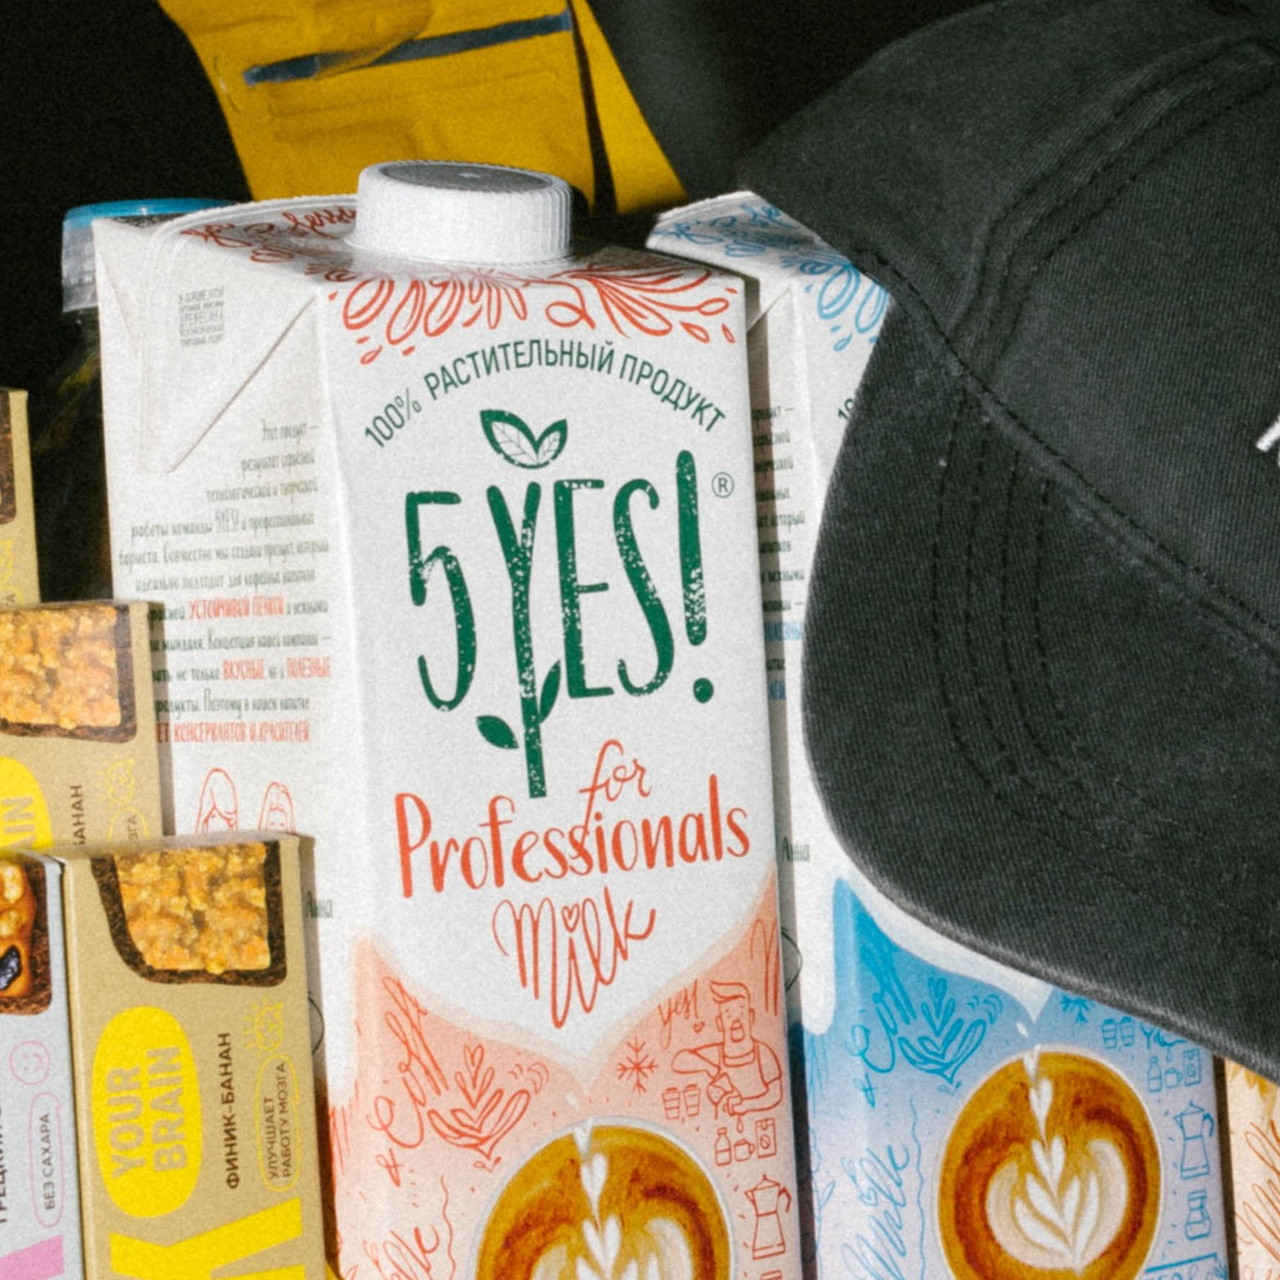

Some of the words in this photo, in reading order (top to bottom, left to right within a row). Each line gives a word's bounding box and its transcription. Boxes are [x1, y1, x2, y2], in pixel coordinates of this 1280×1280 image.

[363, 386, 423, 449] 100%
[423, 338, 615, 401] РАСТИТЕЛЬНЫЙ
[618, 352, 727, 433] ПРОДУКТ
[394, 773, 751, 900] Professionals
[579, 738, 652, 859] for
[105, 1064, 147, 1180] YOUR
[146, 1044, 189, 1173] BRAIN
[216, 1031, 242, 1190] ФИНИК-БАНАН
[261, 1095, 280, 1180] УЛУЧШАЕТ
[275, 1061, 290, 1111] МОЗГА
[38, 1112, 55, 1178] САХАРА
[44, 1181, 56, 1211] БЕЗ
[279, 1113, 294, 1179] РАБОТУ
